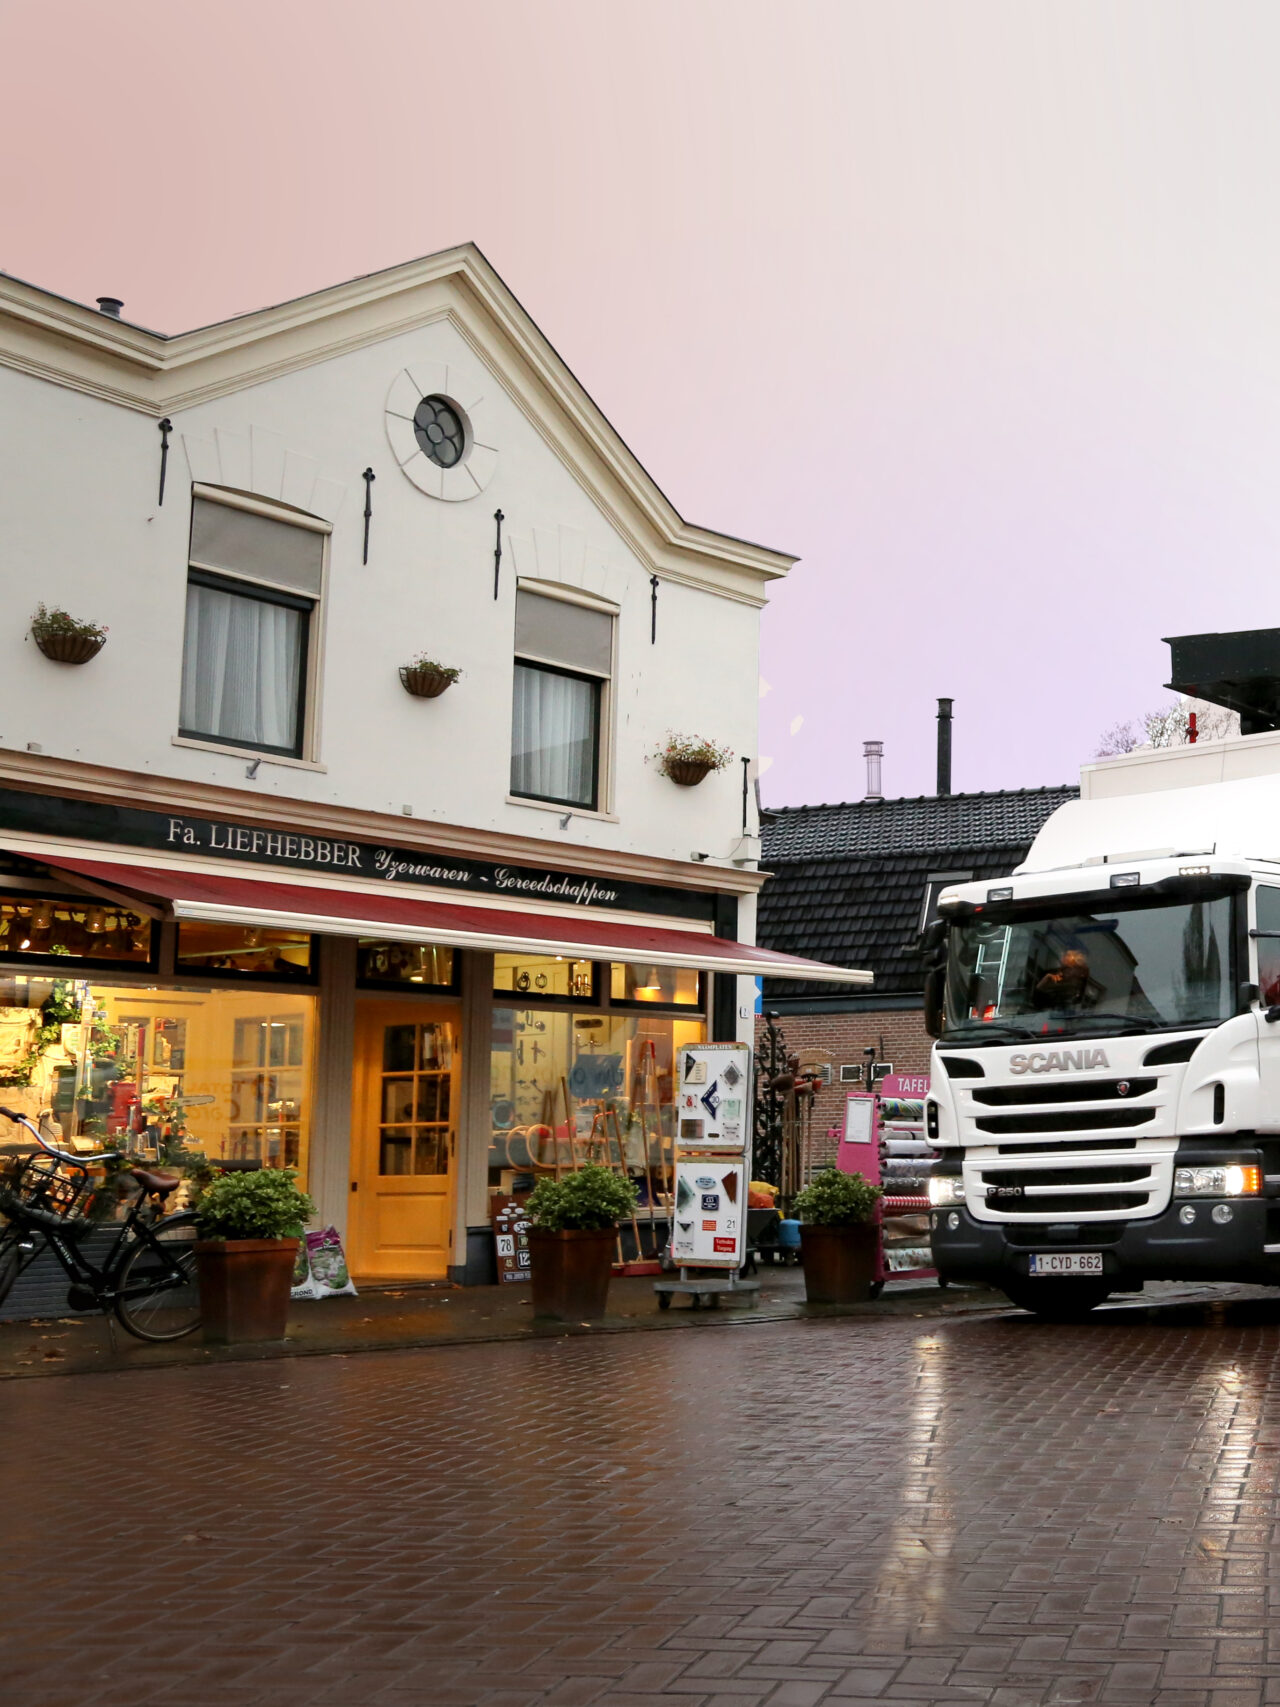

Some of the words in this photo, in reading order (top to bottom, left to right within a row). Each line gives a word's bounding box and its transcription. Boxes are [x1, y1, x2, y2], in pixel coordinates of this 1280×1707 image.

[166, 818, 201, 845] Fa.
[209, 825, 362, 867] LIEFHEBBER
[375, 850, 472, 880] Yzerwaren
[494, 867, 619, 905] Gereedschappen
[1009, 1048, 1111, 1075] SCANIA
[988, 1187, 997, 1197] P
[998, 1186, 1022, 1196] 250
[726, 1219, 736, 1229] 21
[500, 1238, 512, 1252] 78
[1038, 1255, 1101, 1270] 1-CYD-662
